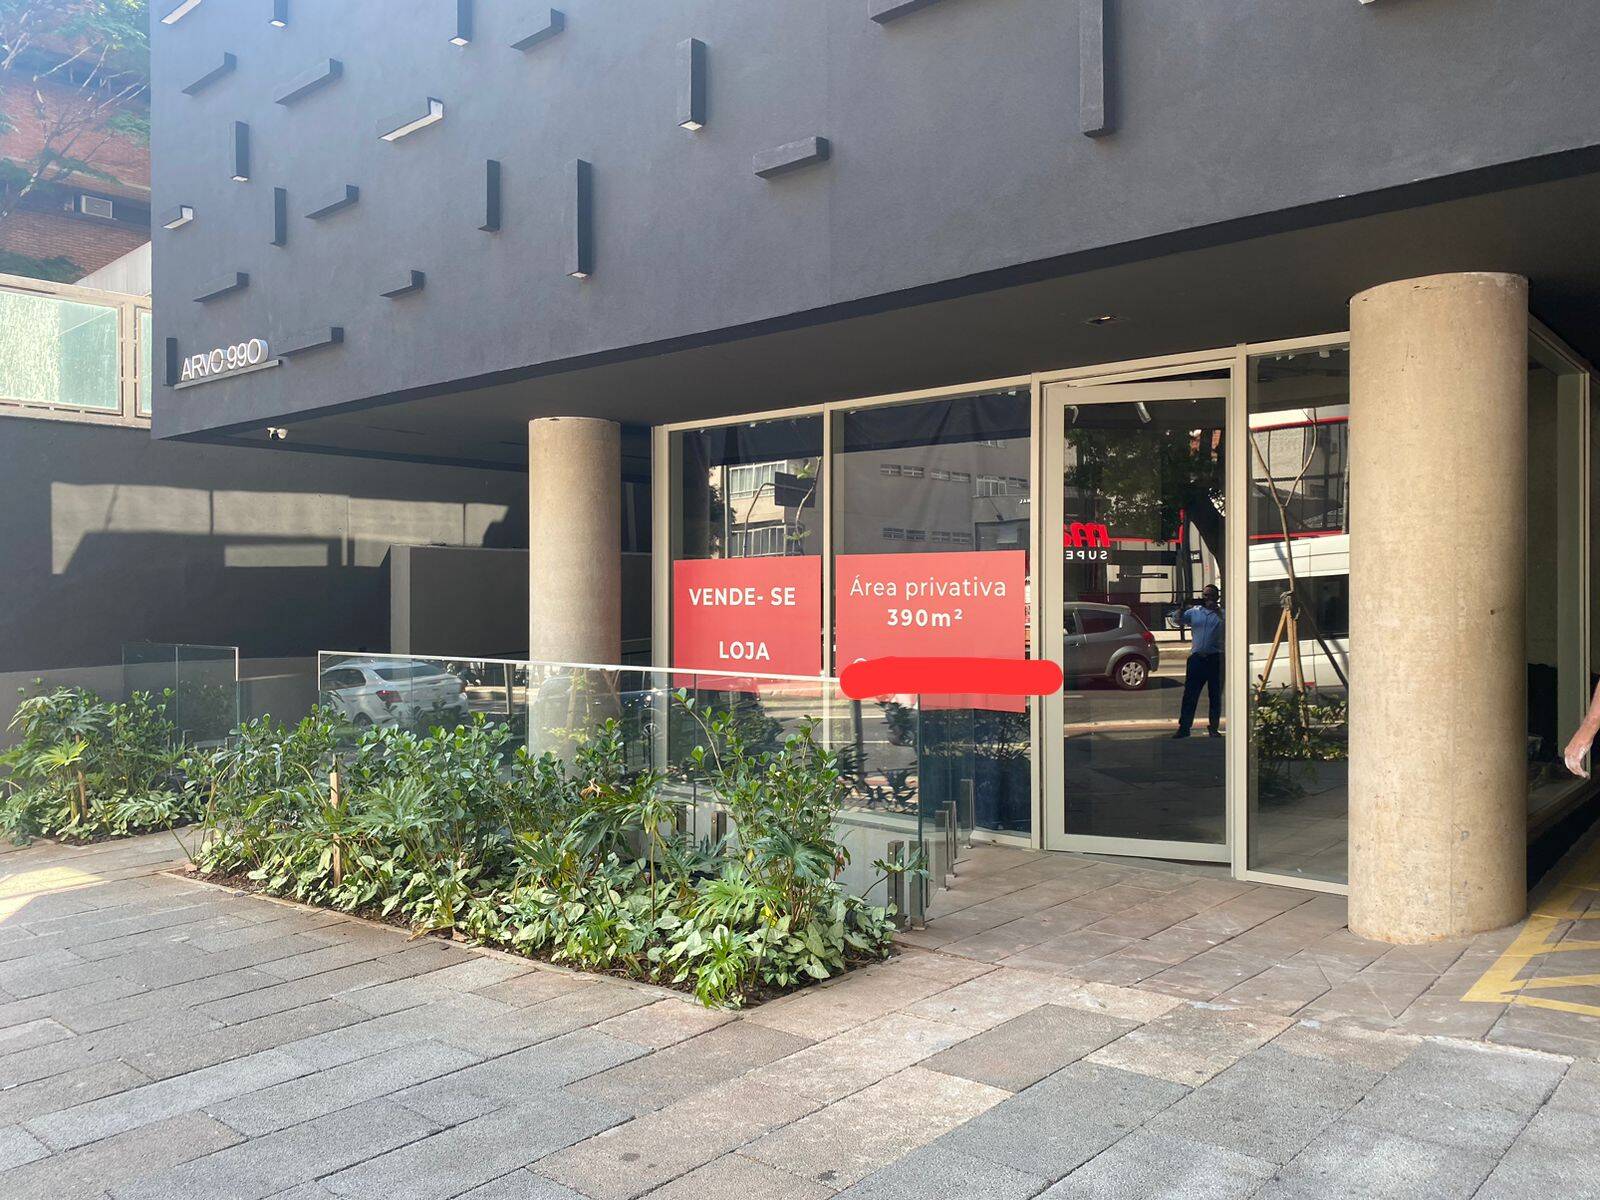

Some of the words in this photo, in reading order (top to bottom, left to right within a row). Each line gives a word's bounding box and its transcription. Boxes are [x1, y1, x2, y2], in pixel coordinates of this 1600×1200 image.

[181, 348, 224, 381] ARVO
[226, 338, 264, 370] 990
[688, 587, 764, 606] VENDE-
[770, 586, 796, 606] SE
[850, 574, 898, 597] Área
[905, 575, 1007, 600] privativa
[886, 607, 964, 628] 390m²
[718, 640, 771, 661] LOJA
